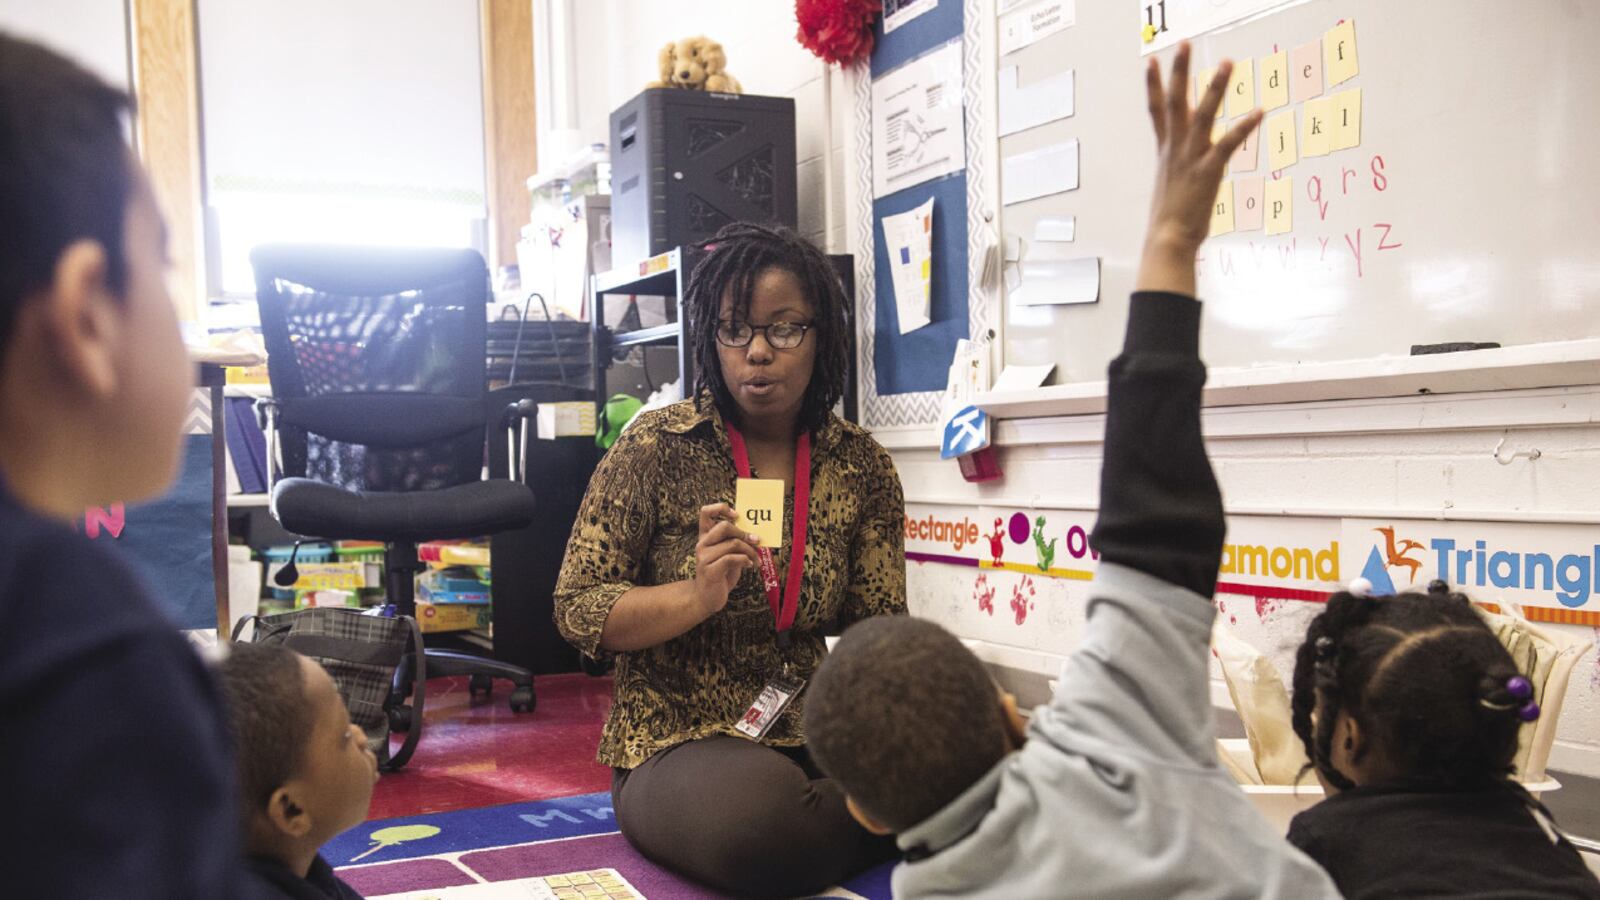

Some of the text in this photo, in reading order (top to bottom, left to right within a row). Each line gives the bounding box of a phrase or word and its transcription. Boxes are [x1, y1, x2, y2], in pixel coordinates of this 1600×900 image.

[1236, 41, 1345, 96] c d e f
[1278, 132, 1285, 153] j
[1312, 117, 1322, 135] k
[1246, 196, 1256, 210] o
[1273, 200, 1283, 219] p
[746, 508, 772, 525] qu
[1219, 541, 1340, 582] amond
